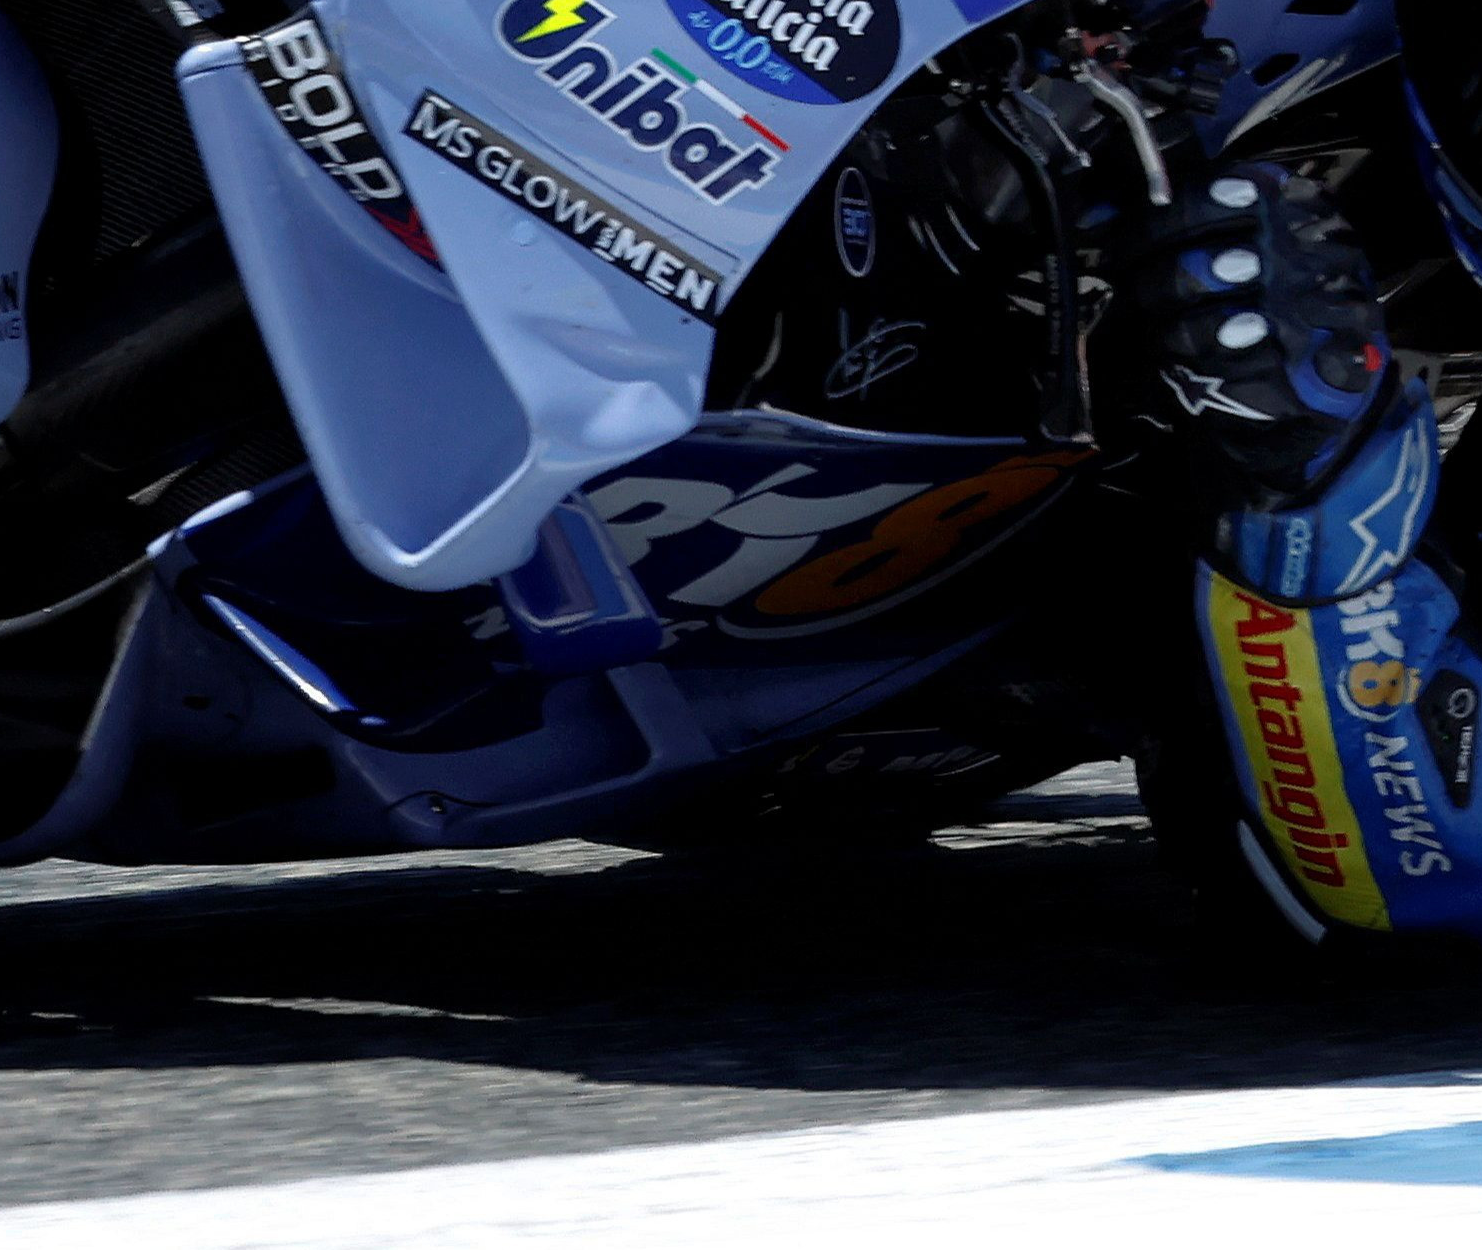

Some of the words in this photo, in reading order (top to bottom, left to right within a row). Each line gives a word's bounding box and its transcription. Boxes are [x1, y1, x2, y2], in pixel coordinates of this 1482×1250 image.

[264, 20, 405, 202] BOLD
[411, 96, 473, 161] MS
[475, 145, 608, 235] GLOW
[614, 227, 719, 311] MEN
[1233, 591, 1350, 888] Antangin
[1336, 581, 1407, 720] BK8
[1365, 733, 1452, 876] NEWS
